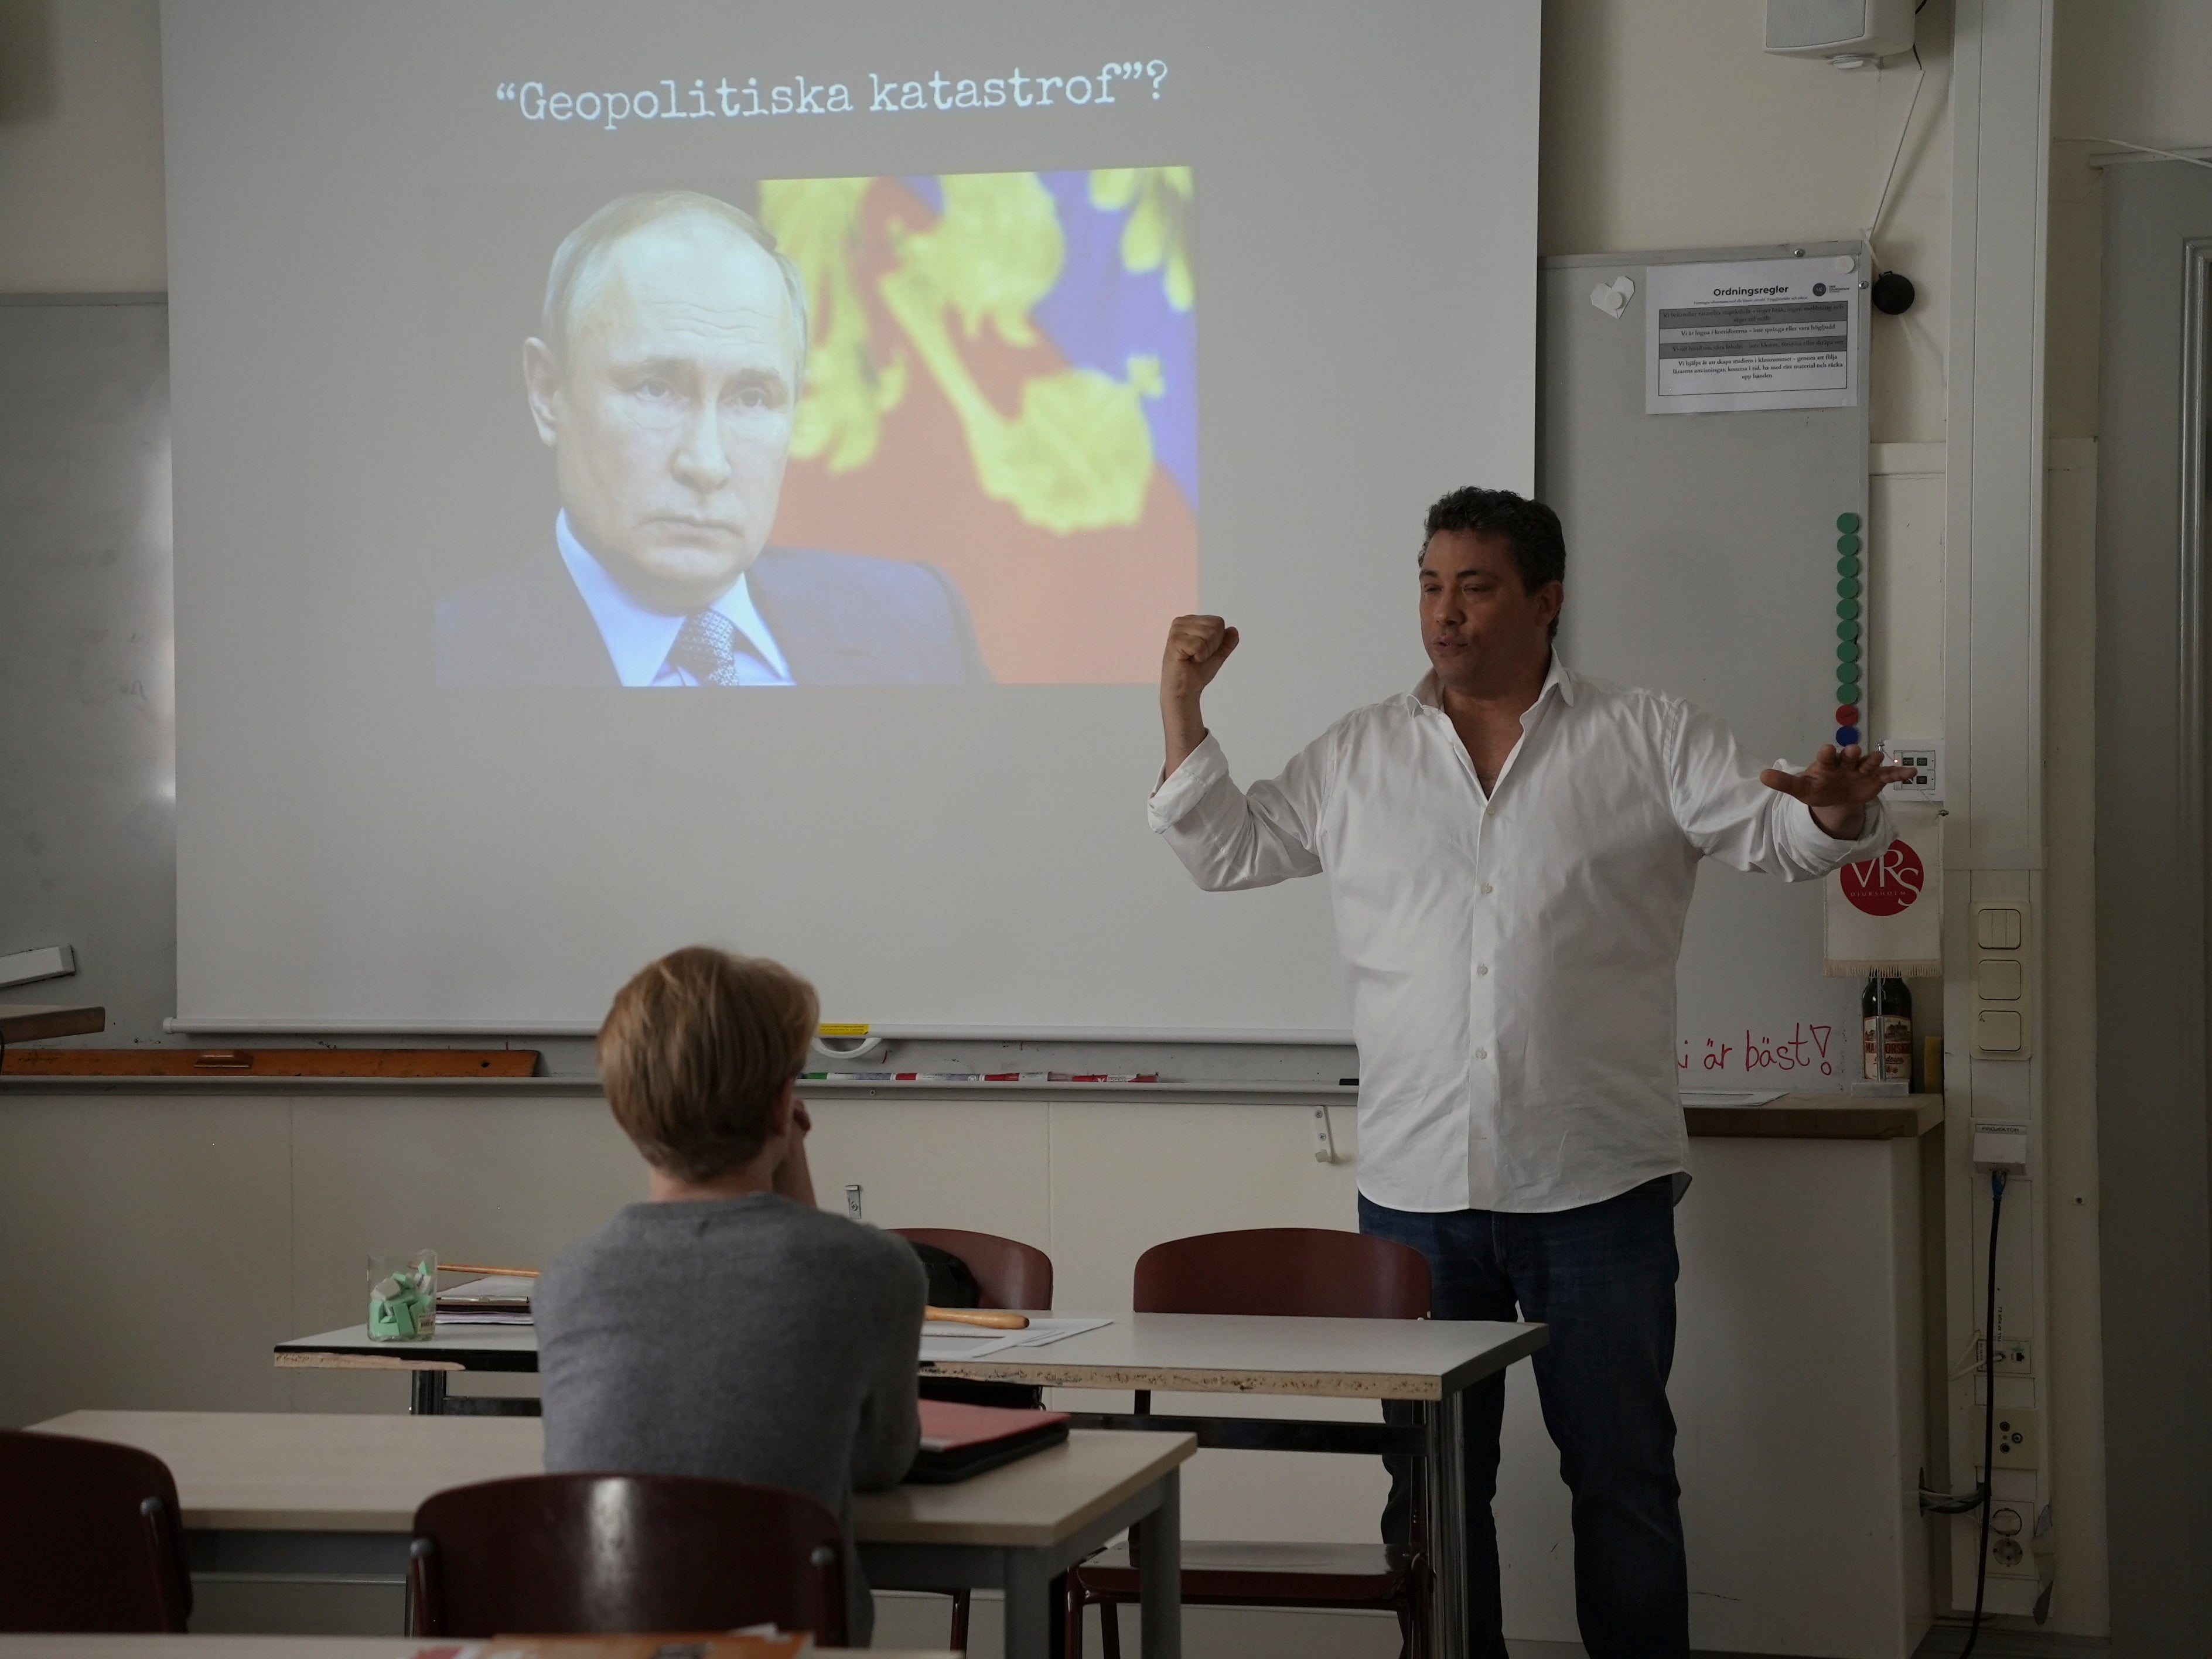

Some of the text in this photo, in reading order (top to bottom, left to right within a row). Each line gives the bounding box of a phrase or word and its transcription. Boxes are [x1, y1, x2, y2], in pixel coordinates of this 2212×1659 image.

[1713, 285, 1788, 296] Ordningsregler
[1851, 849, 1921, 906] VRS
[1678, 1022, 1832, 1076] i är bäst!
